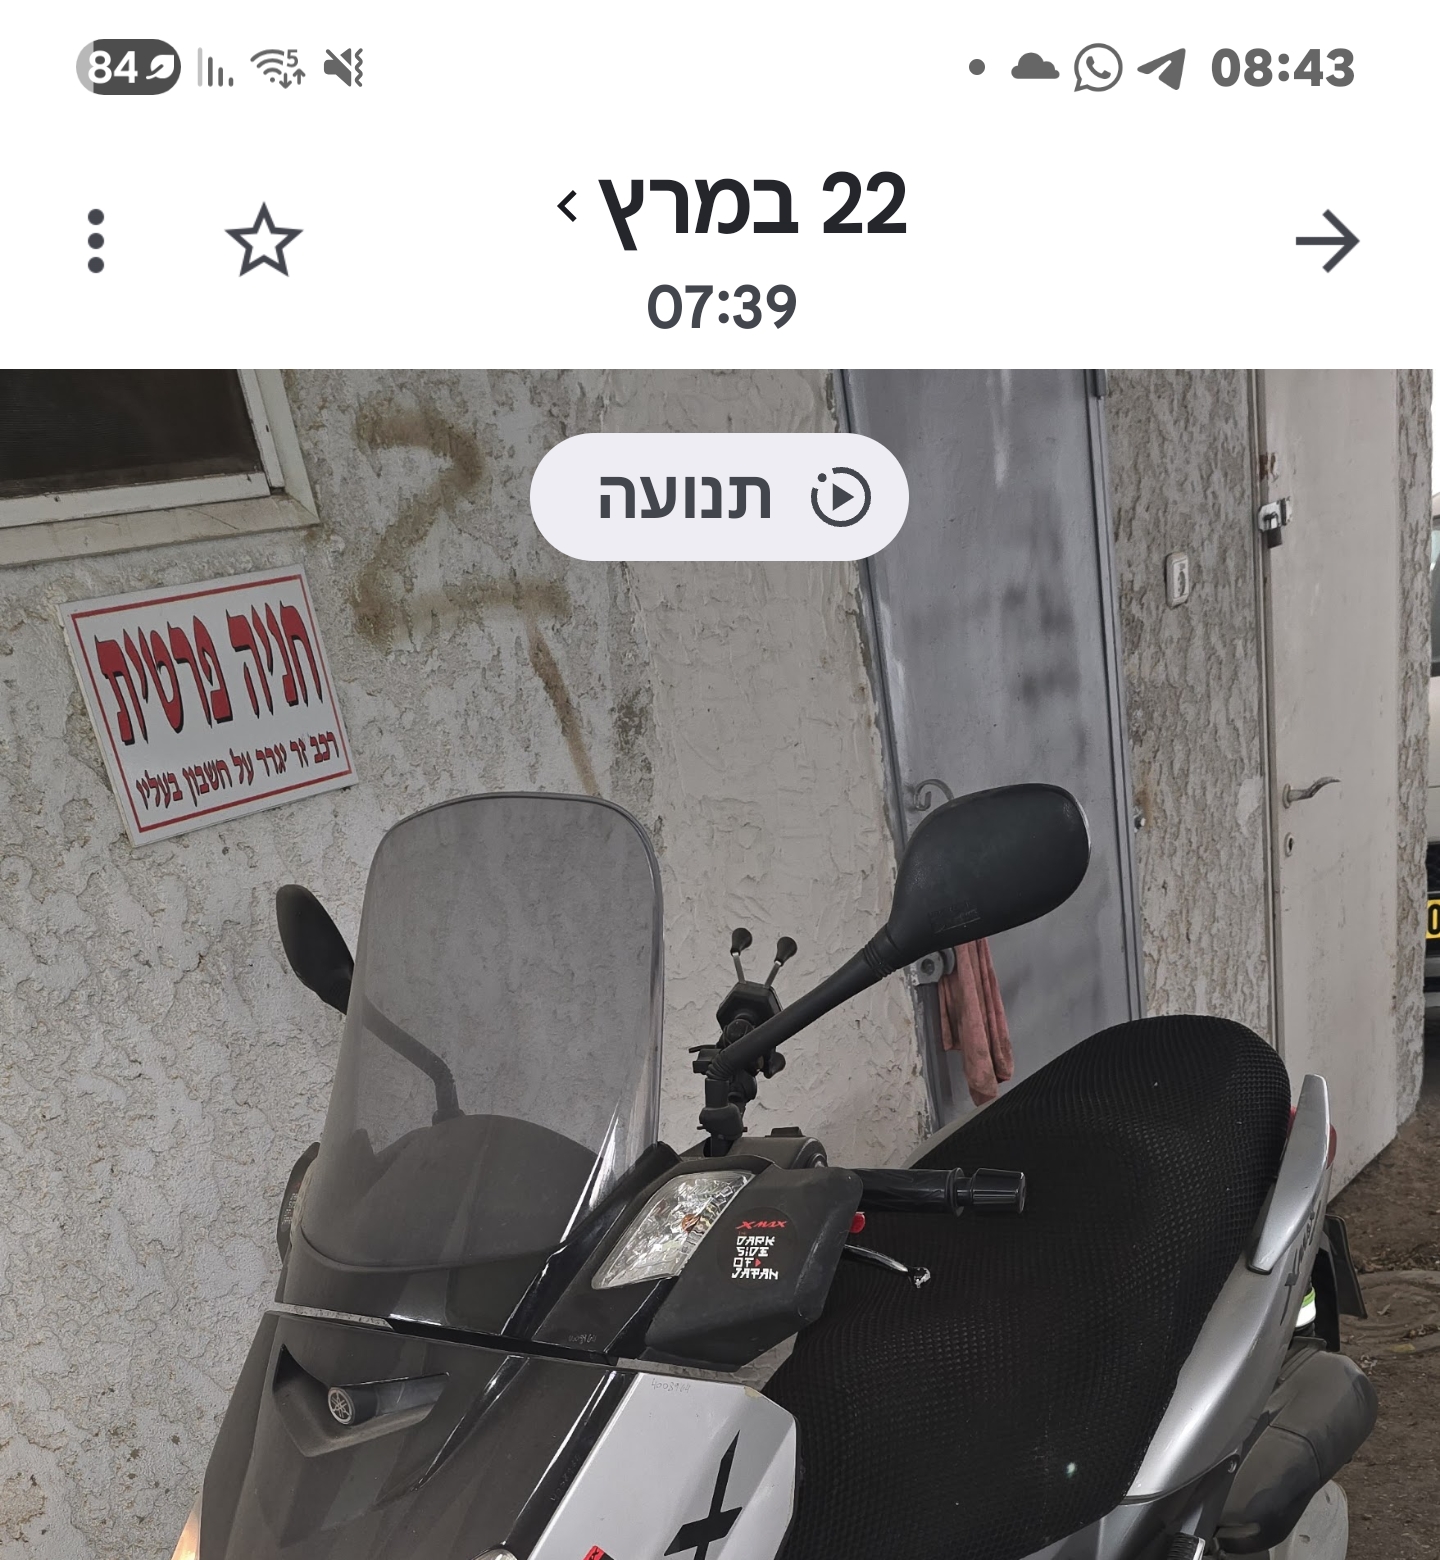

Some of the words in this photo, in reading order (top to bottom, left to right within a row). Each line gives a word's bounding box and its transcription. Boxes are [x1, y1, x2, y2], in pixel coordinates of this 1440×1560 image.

[226, 600, 323, 719] חניה
[94, 615, 233, 746] פרטית
[255, 743, 287, 777] יגרר
[290, 738, 309, 768] זר
[309, 731, 340, 764] רכב
[182, 759, 232, 807] חשבון
[229, 748, 254, 786] על
[136, 770, 183, 810] בעליו
[736, 1235, 776, 1246] DARK
[731, 1267, 779, 1280] JAPAN
[733, 1257, 755, 1268] OF
